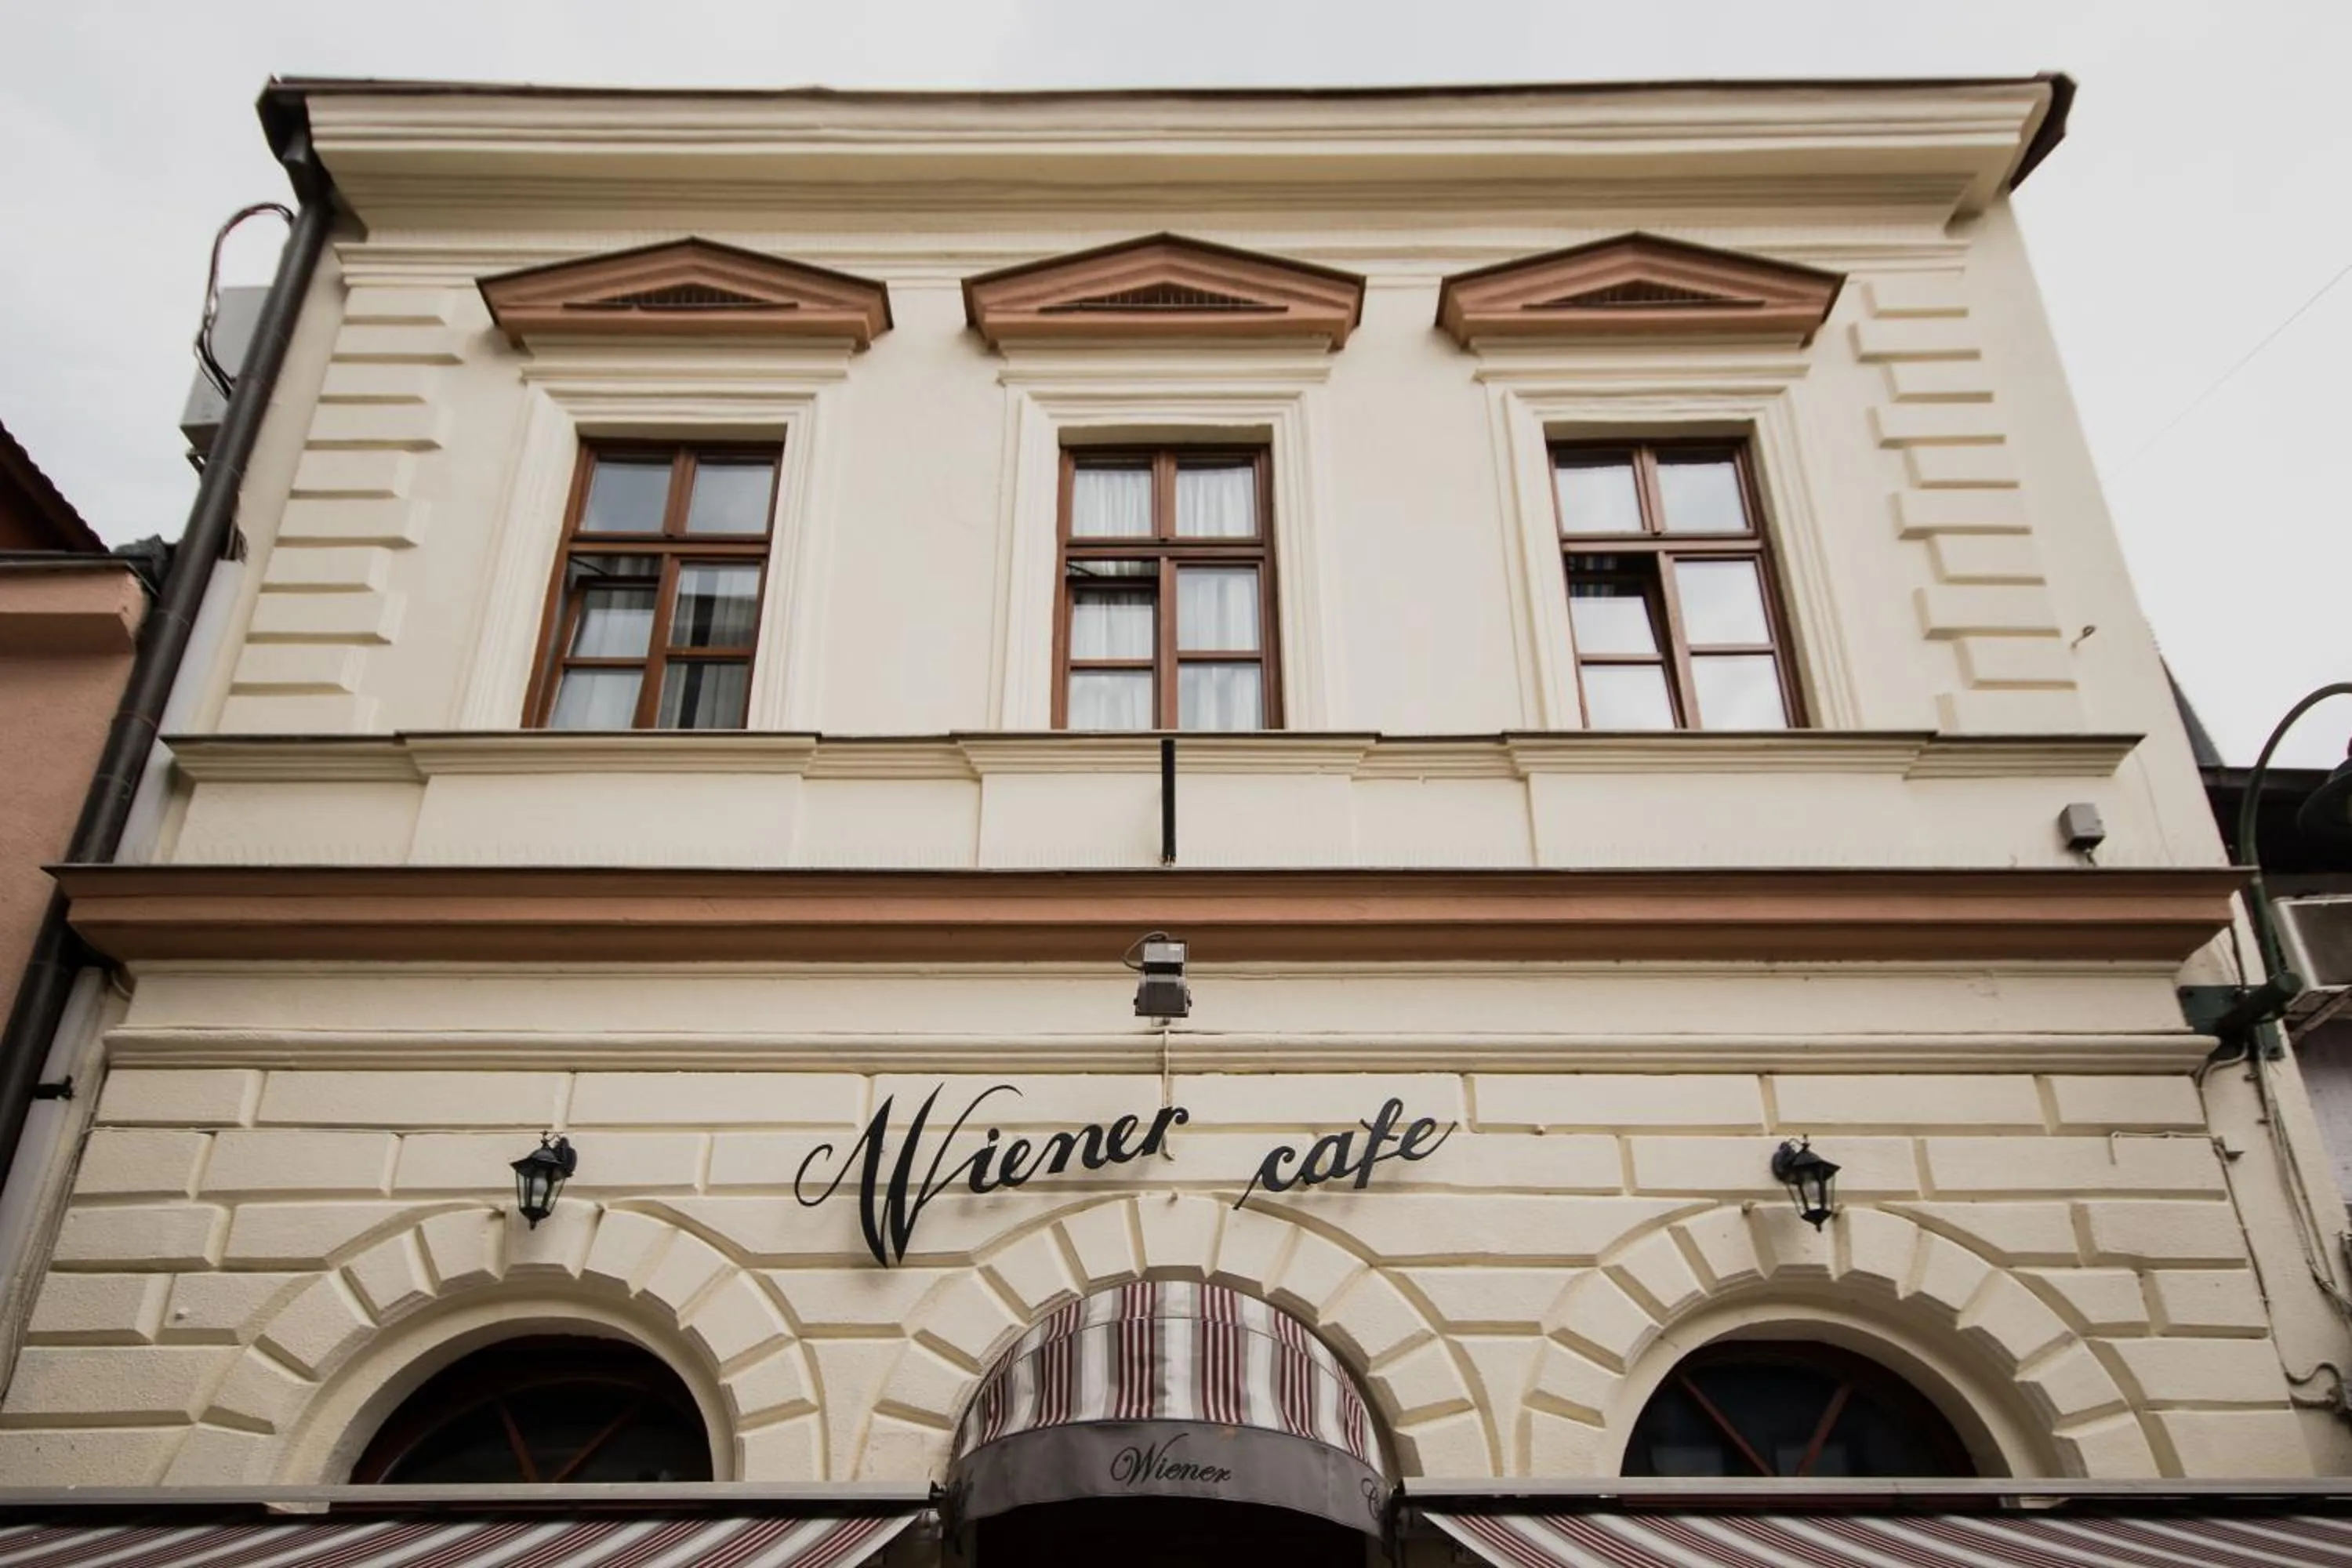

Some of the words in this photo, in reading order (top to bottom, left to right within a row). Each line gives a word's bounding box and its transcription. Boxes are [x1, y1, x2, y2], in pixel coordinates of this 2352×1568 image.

[794, 1082, 1189, 1268] Wiener
[1232, 1097, 1459, 1210] cafe
[1110, 1433, 1231, 1486] Wiener
